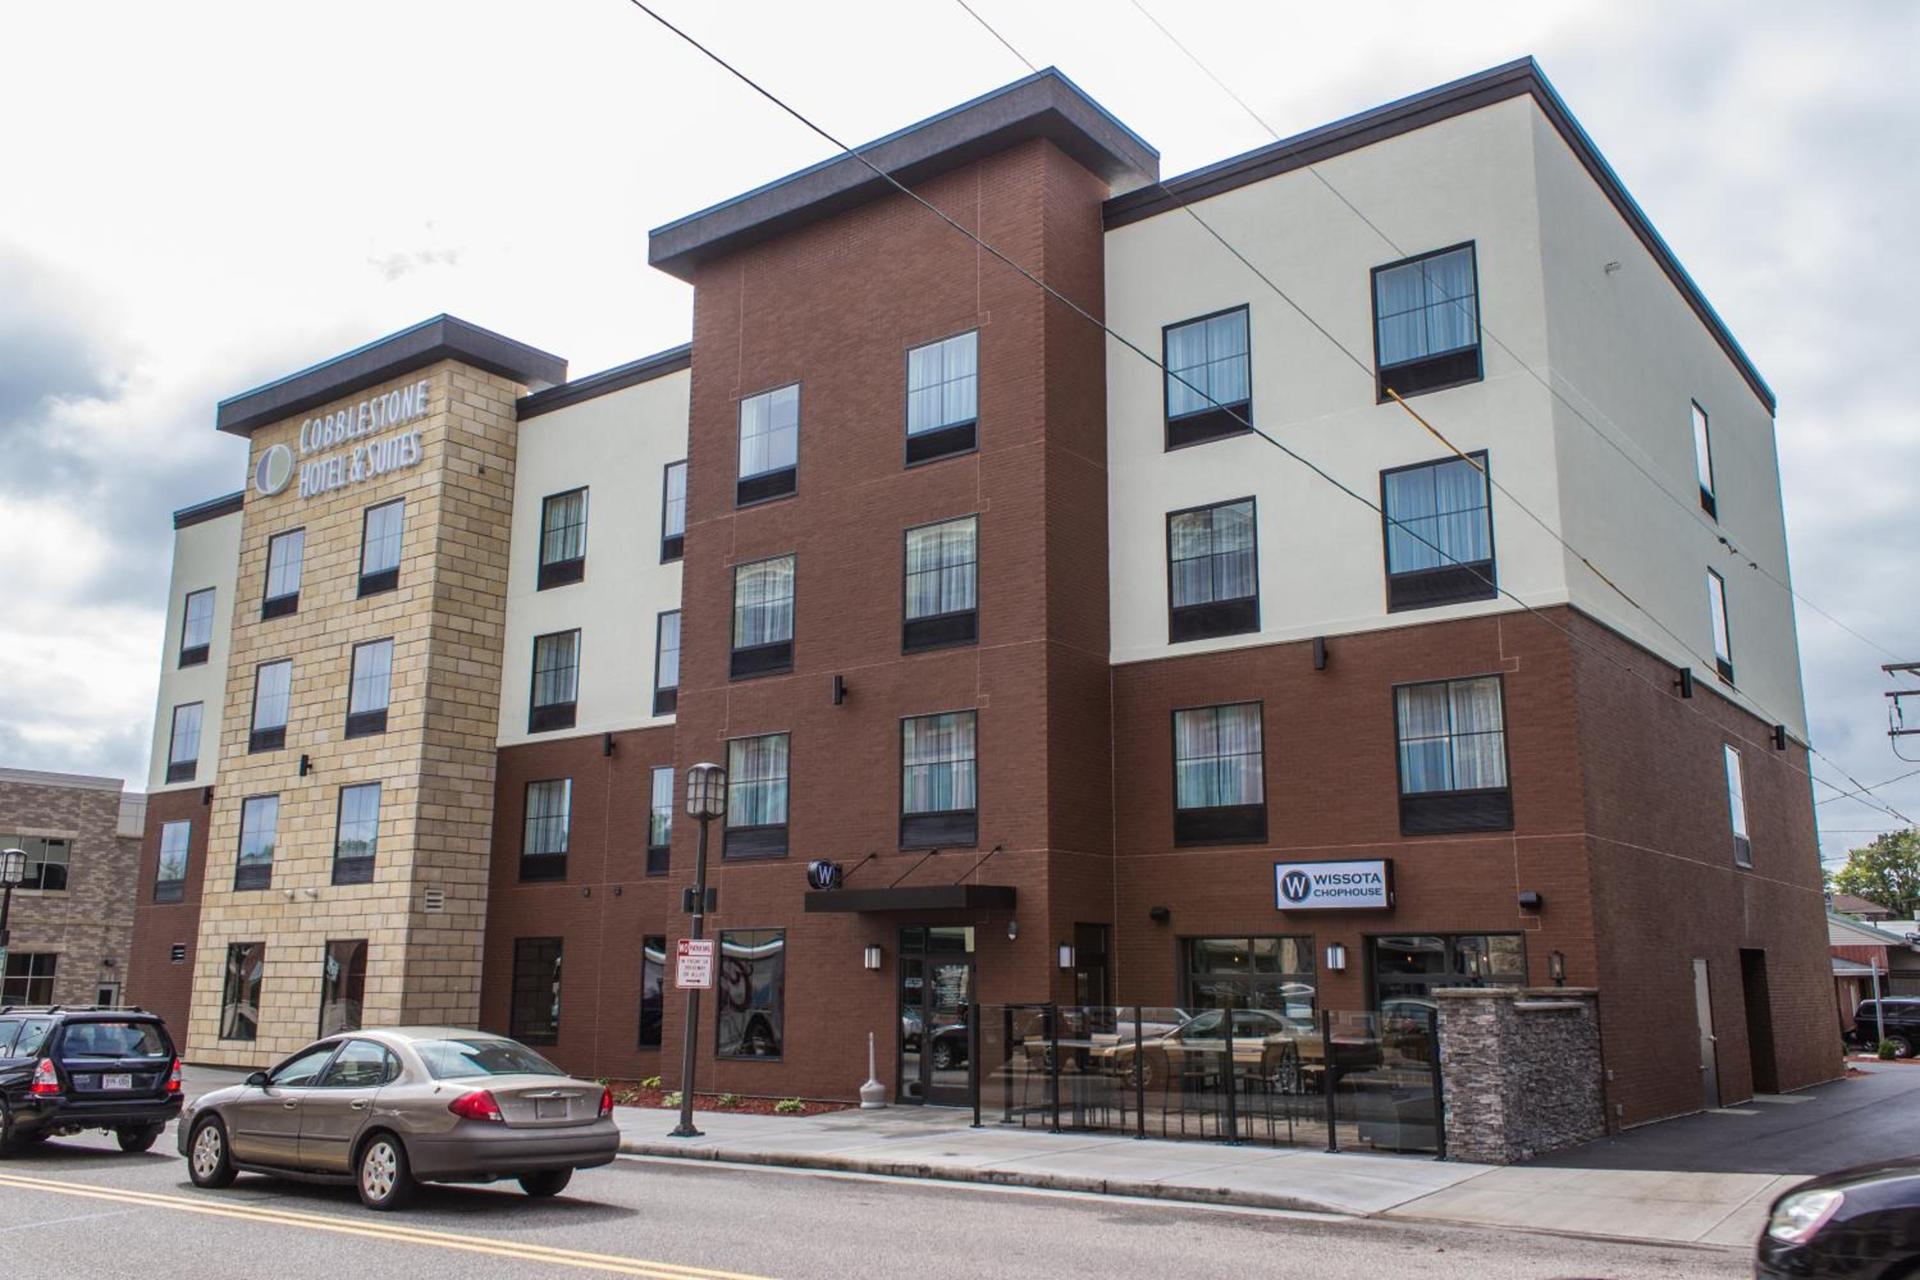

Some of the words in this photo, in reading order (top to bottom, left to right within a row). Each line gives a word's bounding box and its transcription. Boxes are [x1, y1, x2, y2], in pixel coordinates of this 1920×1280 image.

[300, 379, 429, 455] COBBLESTONE
[299, 455, 347, 498] HOTEL
[351, 446, 367, 484] &
[367, 427, 423, 479] SUITES
[818, 864, 832, 885] W
[1312, 872, 1382, 885] WISSOTA
[1285, 875, 1306, 899] W
[1312, 887, 1383, 897] CHOPHOUSE
